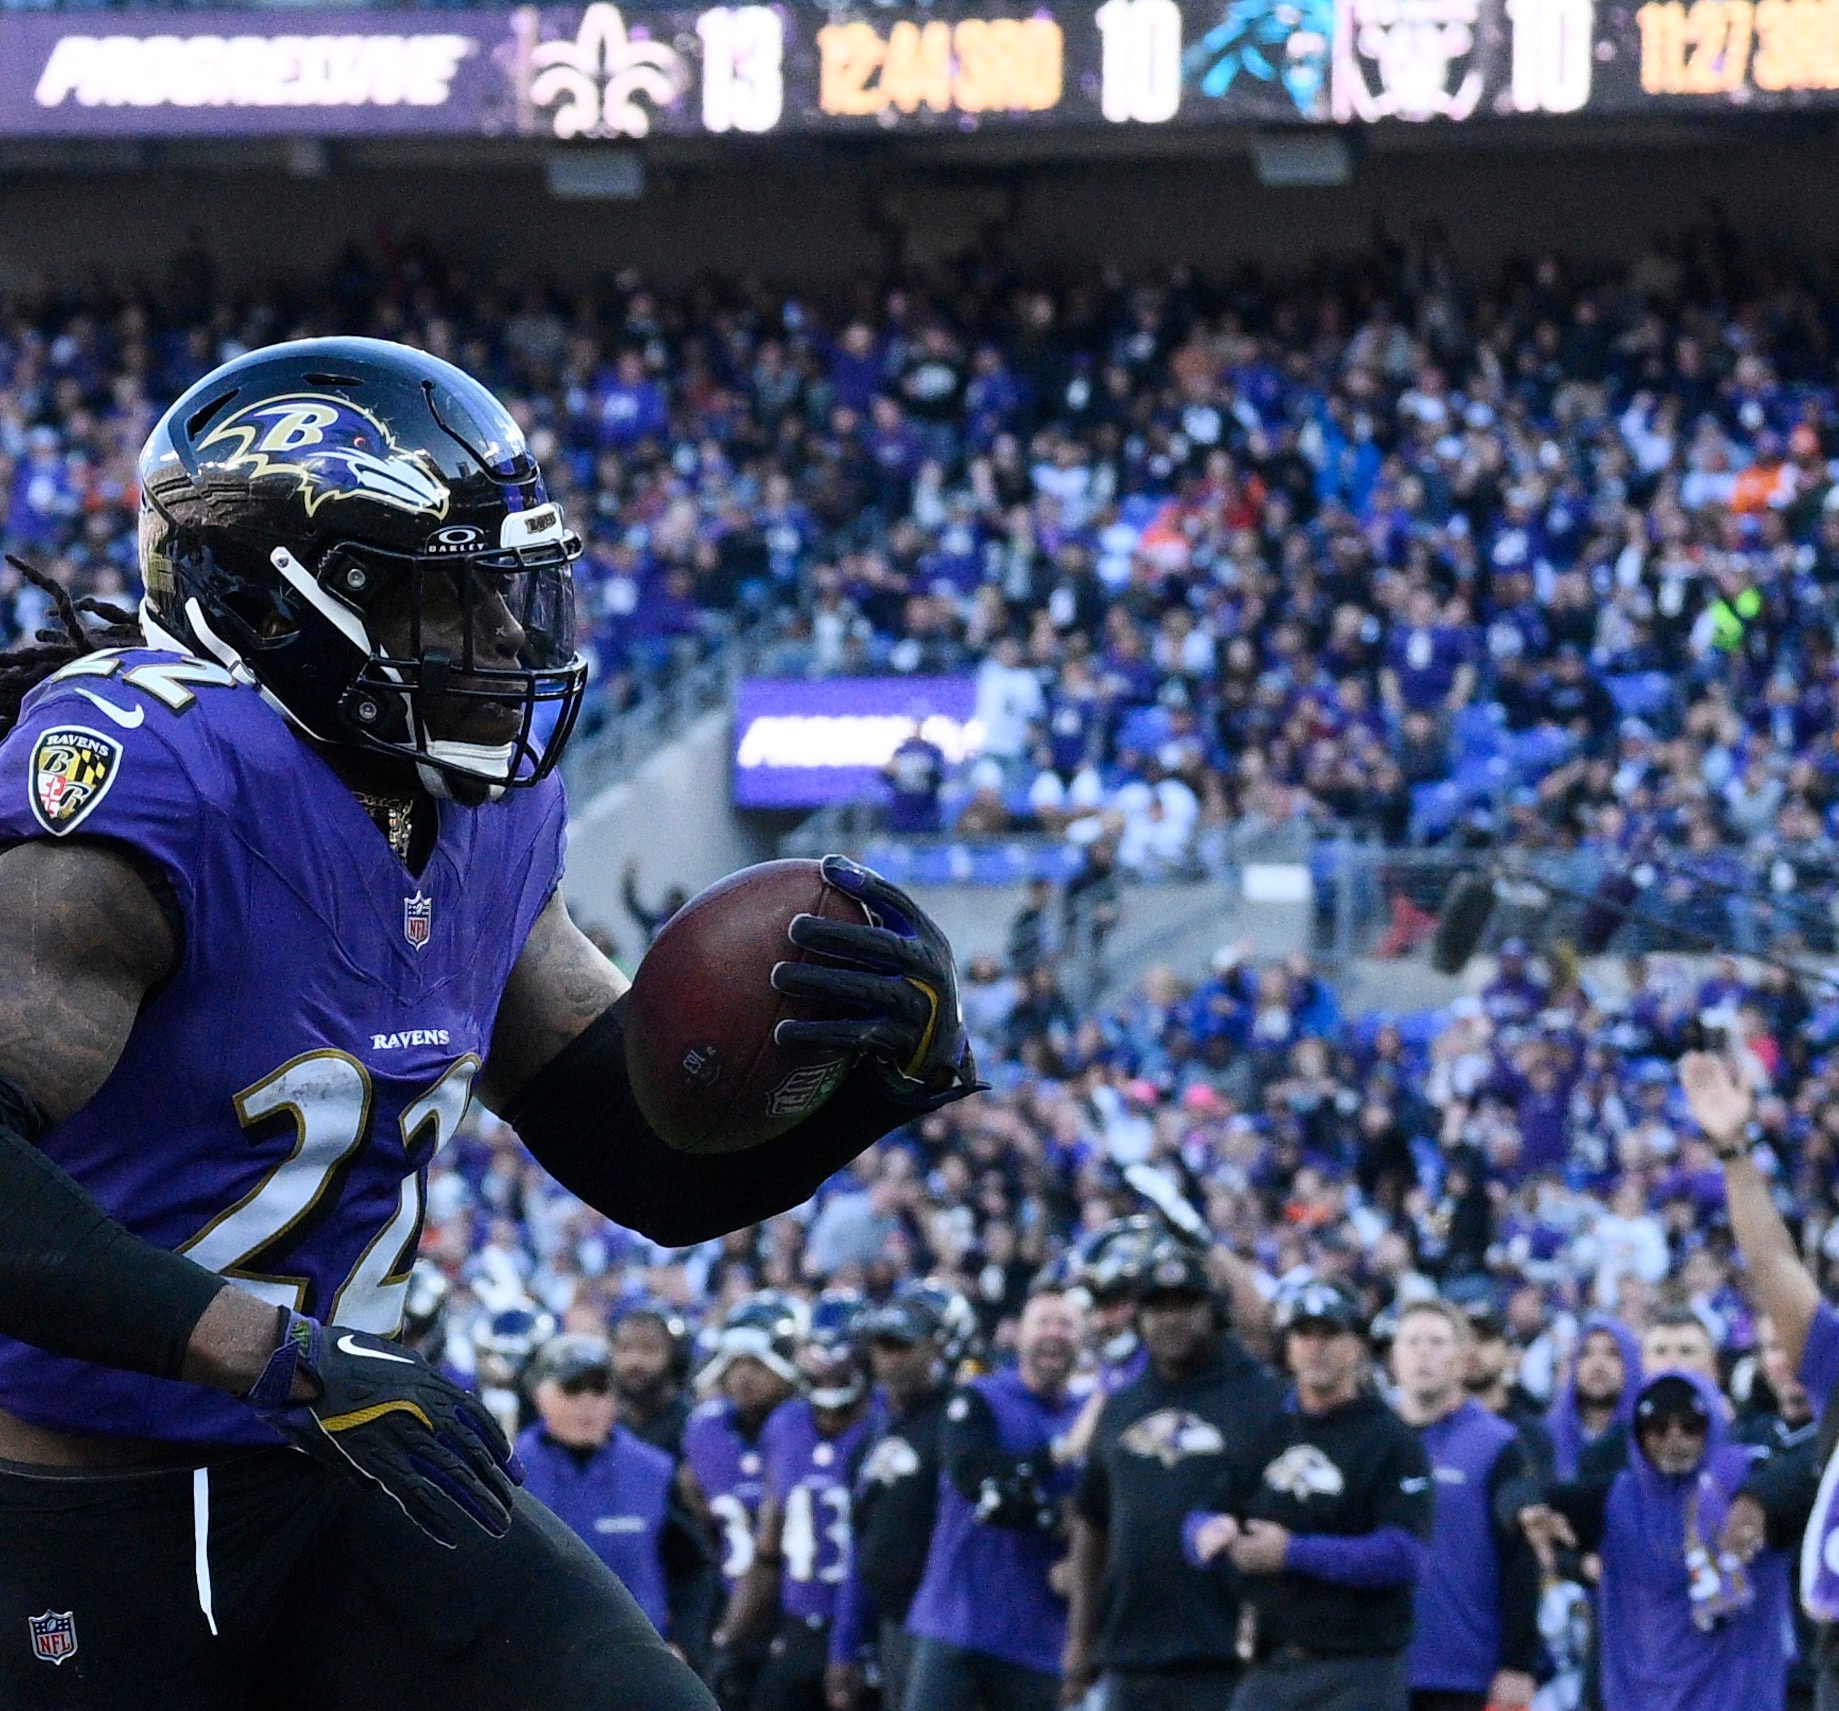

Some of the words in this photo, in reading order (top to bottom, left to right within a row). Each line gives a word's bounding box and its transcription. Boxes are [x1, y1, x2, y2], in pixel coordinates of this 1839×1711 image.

[35, 34, 473, 106] PROGRESSIVE
[700, 4, 784, 133] 13
[1097, 0, 1182, 123] 10
[1513, 0, 1593, 113] 10
[254, 402, 339, 452] B
[428, 542, 485, 553] OAKLEY
[40, 746, 76, 776] B
[47, 734, 110, 757] RAVENS
[409, 918, 427, 940] NFL
[371, 1029, 451, 1050] RAVENS
[173, 1047, 482, 1341] 22
[39, 1633, 71, 1655] NFL
